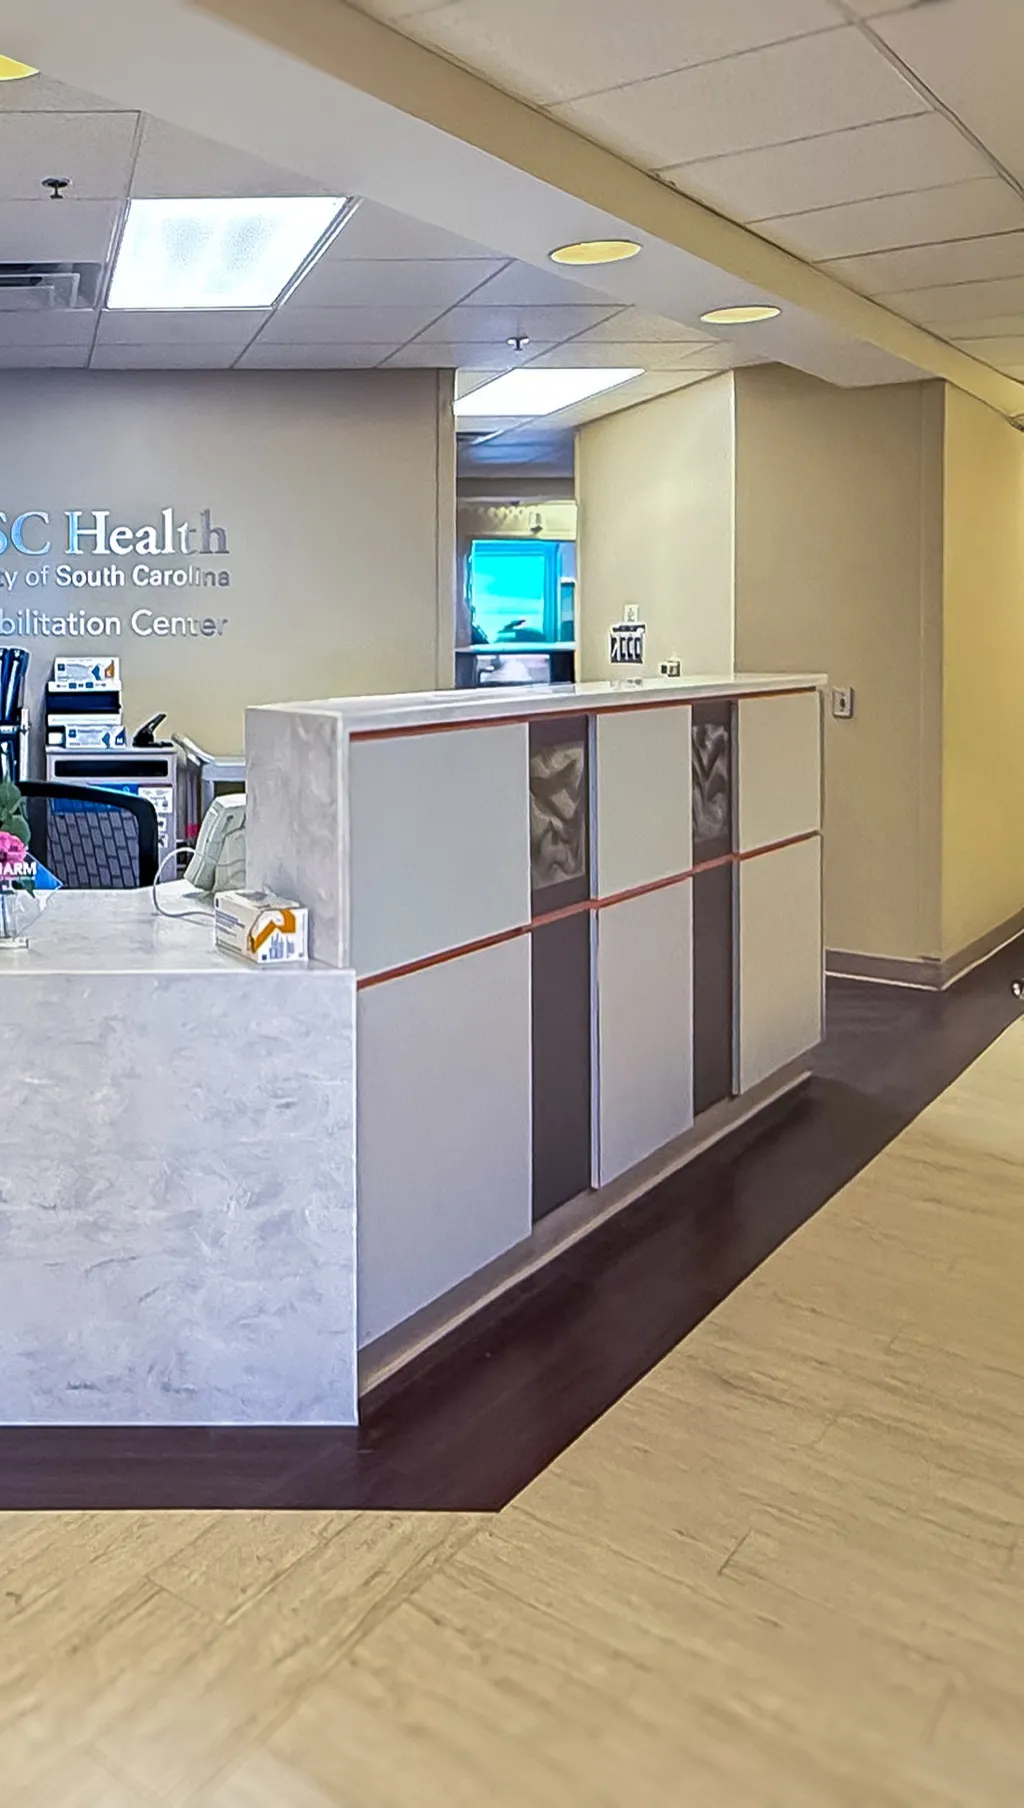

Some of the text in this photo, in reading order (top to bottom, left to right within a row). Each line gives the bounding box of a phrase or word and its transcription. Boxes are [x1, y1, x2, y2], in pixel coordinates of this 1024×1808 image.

[65, 507, 230, 555] Health
[26, 565, 50, 588] of
[56, 565, 125, 588] South
[133, 564, 230, 588] Carolina
[131, 610, 228, 637] Center
